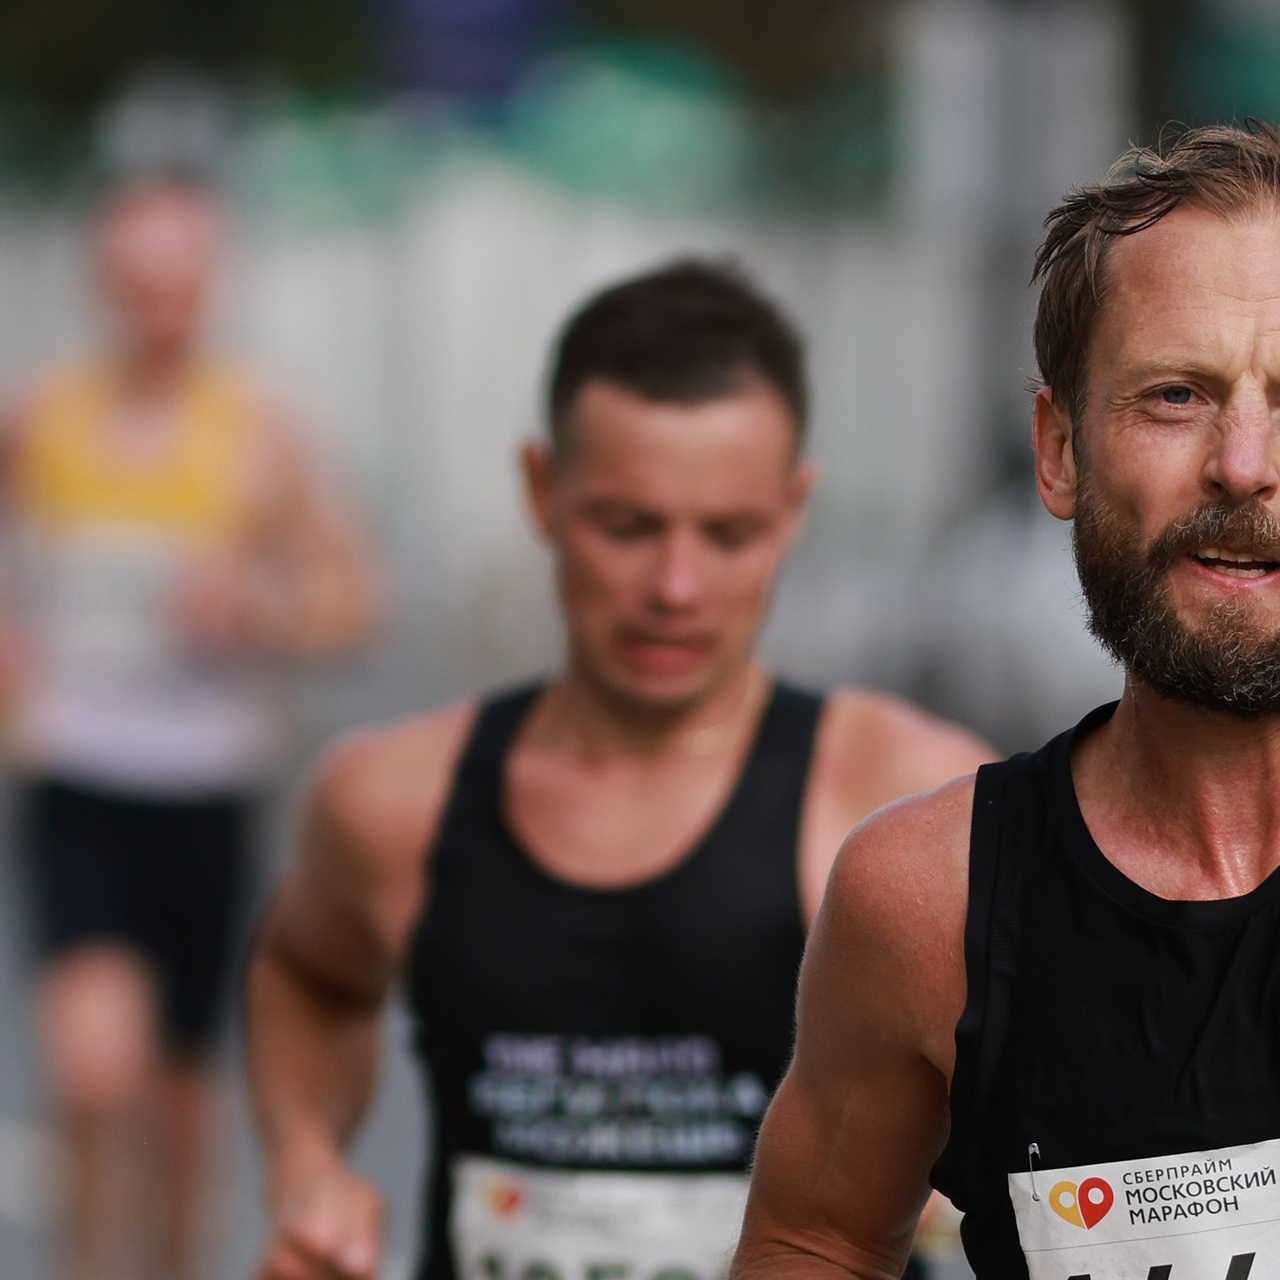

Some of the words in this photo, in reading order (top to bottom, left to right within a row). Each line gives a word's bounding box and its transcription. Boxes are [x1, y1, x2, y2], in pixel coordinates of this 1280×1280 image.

[1122, 1158, 1232, 1185] СБЕРПРАЙМ
[1125, 1166, 1277, 1206] МОСКОВСКИЙ
[1129, 1195, 1240, 1226] МАРАФОН
